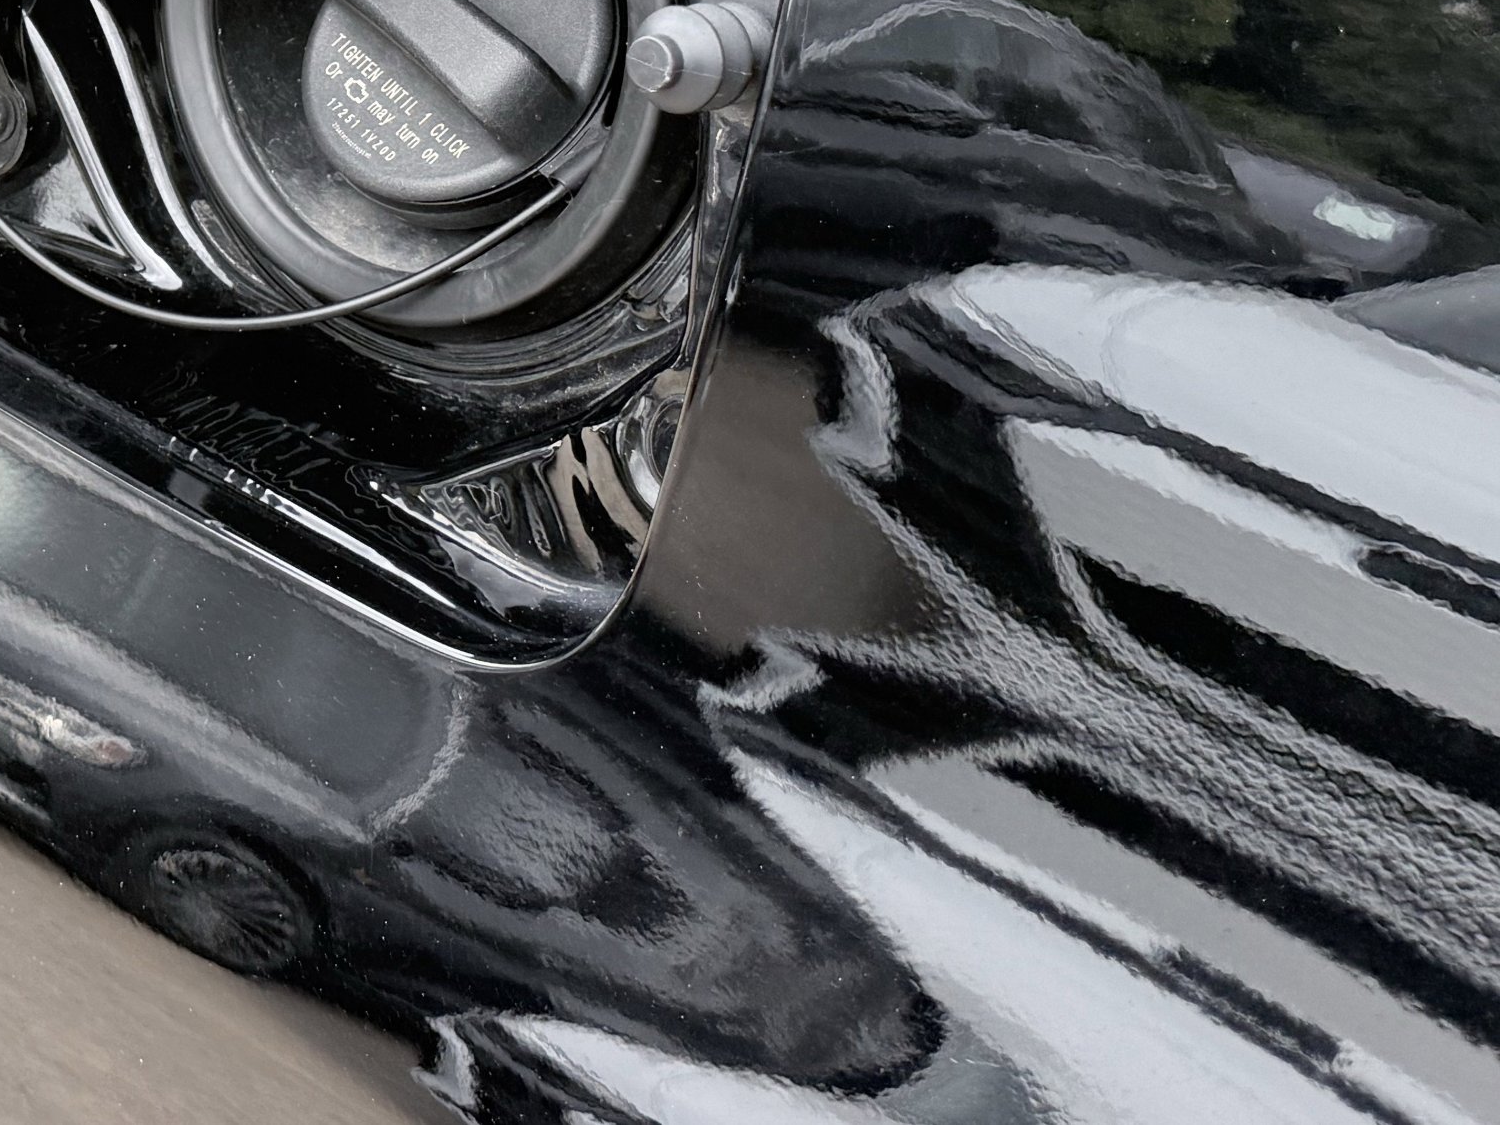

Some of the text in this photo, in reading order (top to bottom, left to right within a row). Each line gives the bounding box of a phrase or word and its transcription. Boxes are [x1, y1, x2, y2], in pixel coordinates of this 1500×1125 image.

[325, 61, 343, 79] Or
[366, 100, 396, 126] may
[395, 123, 421, 149] turn
[421, 148, 439, 165] on
[326, 97, 361, 128] 17251
[330, 32, 470, 159] TIGHTEN UNTIL 1 CLICK
